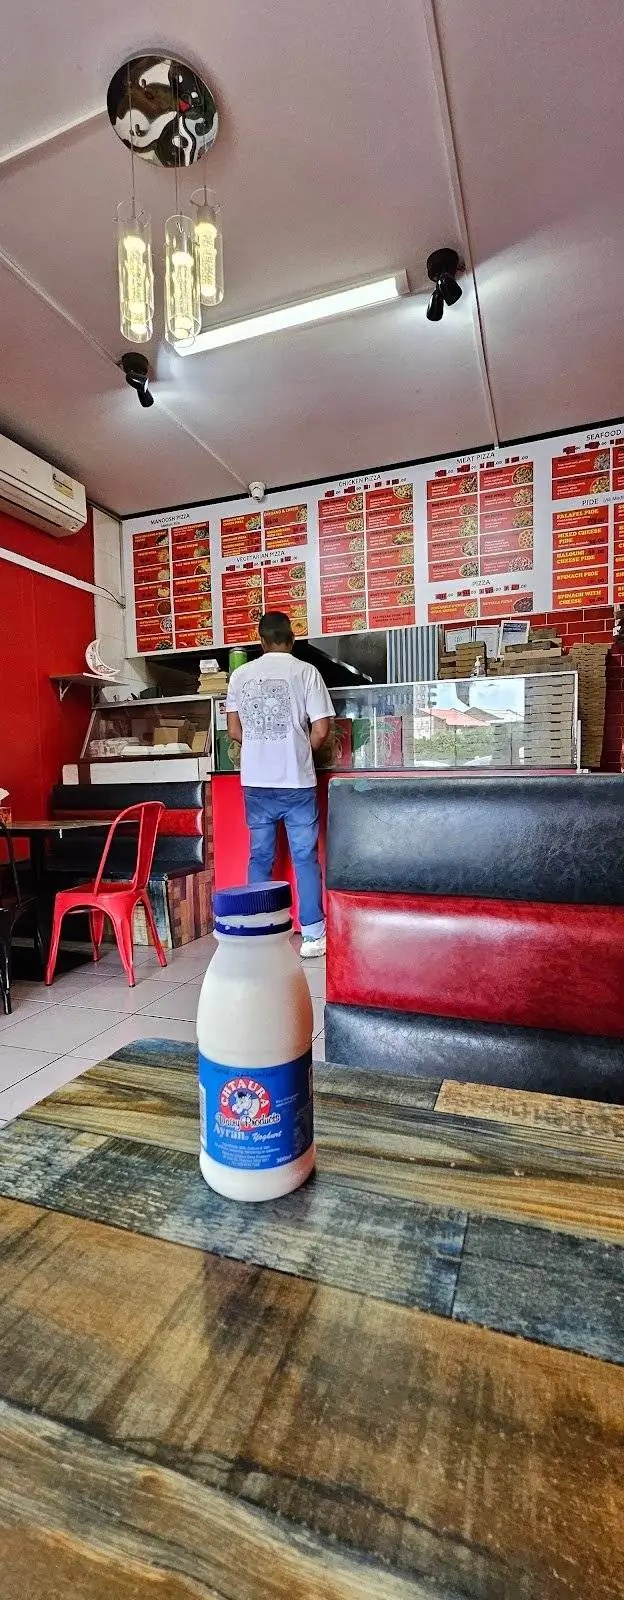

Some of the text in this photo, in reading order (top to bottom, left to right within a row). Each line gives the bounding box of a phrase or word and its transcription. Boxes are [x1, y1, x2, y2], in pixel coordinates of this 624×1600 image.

[586, 429, 622, 441] SEAFOOD
[456, 451, 495, 464] MEAT PIZZA
[338, 474, 382, 488] CHICKEN PIZZA
[582, 498, 599, 506] PIDE
[556, 508, 599, 520] FALAFEL PIDE
[557, 527, 602, 539] MIXED CHEESE
[235, 550, 286, 563] VEGETARIAN PIZZA
[556, 554, 596, 565] CHEESE PIDE
[556, 570, 599, 581] SPINACH PIDE
[472, 579, 491, 587] PIZZA
[220, 1079, 270, 1108] CHTAURA
[215, 1112, 281, 1131] Dairy Products
[251, 1130, 283, 1143] Yoghurt
